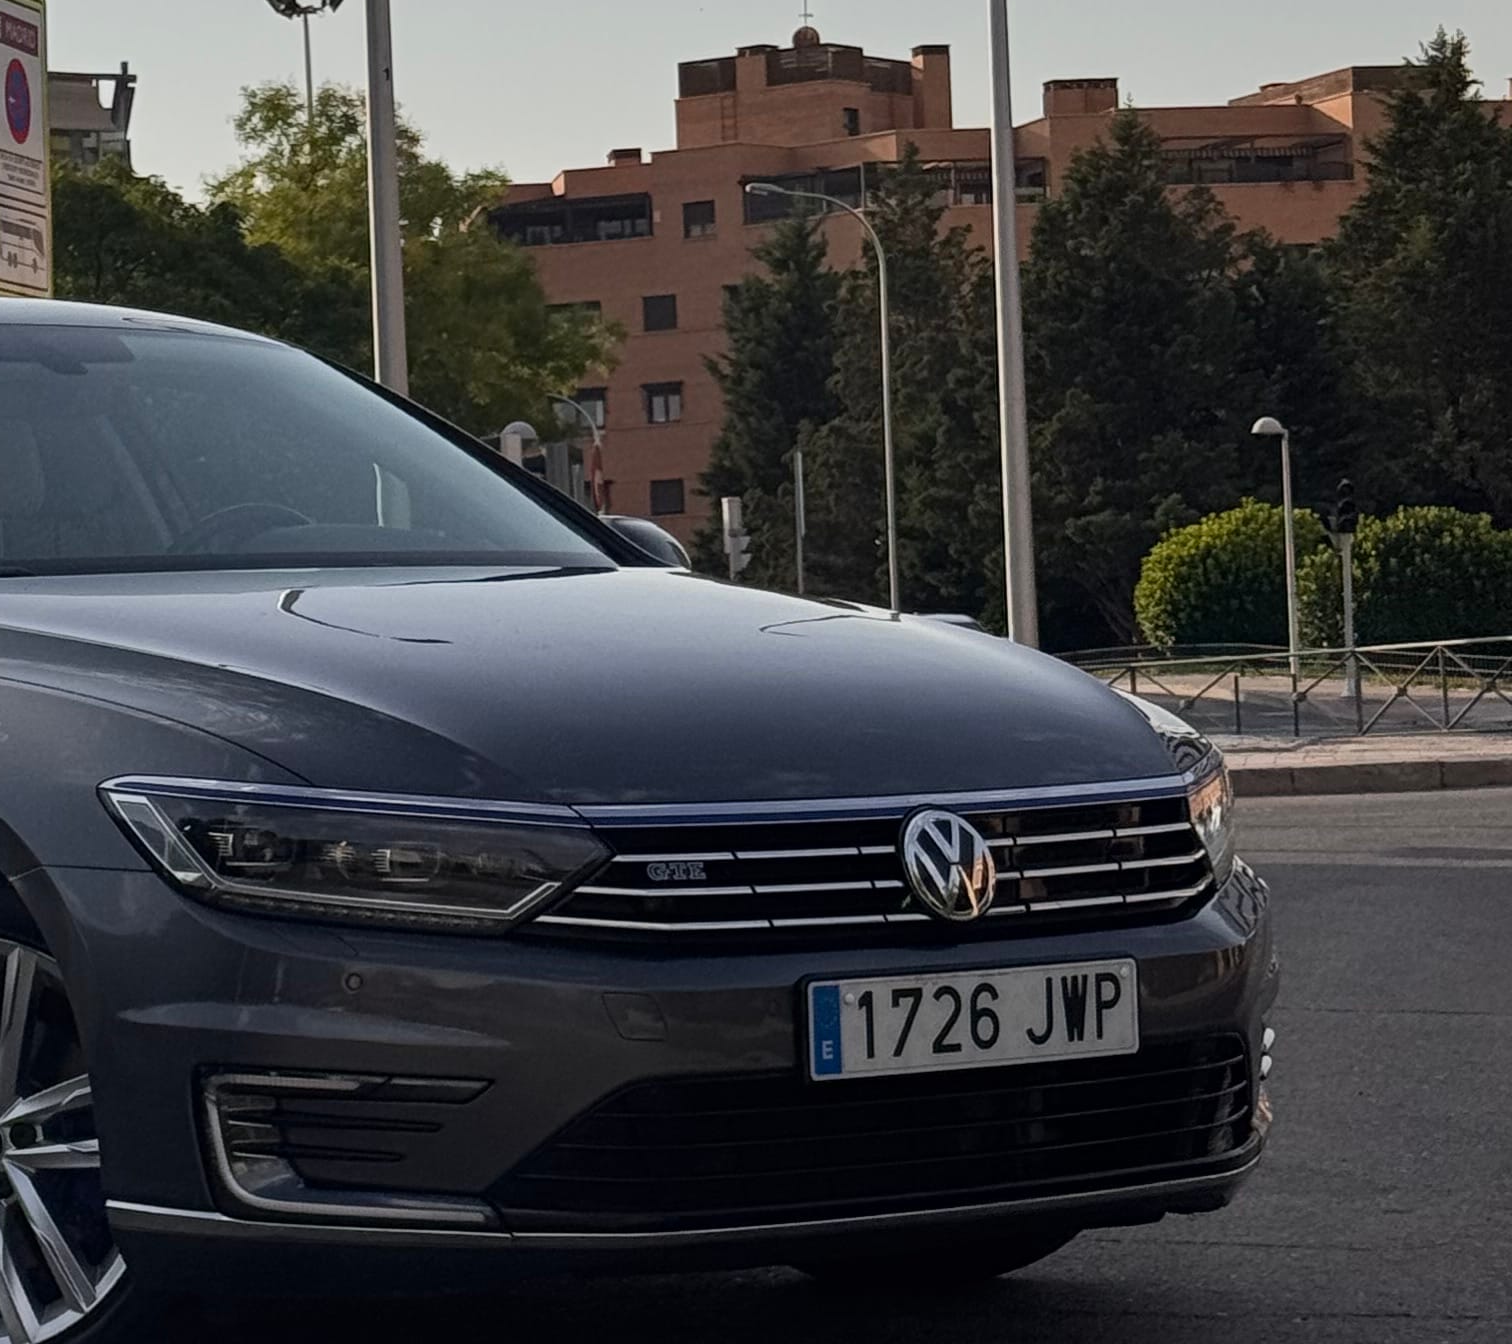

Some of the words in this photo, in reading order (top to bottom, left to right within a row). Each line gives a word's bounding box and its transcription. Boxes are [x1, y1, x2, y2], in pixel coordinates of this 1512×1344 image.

[647, 862, 707, 881] GTE
[903, 807, 996, 920] VW
[858, 982, 1000, 1059] 1726
[1026, 971, 1122, 1045] JWP
[822, 1040, 834, 1060] E
